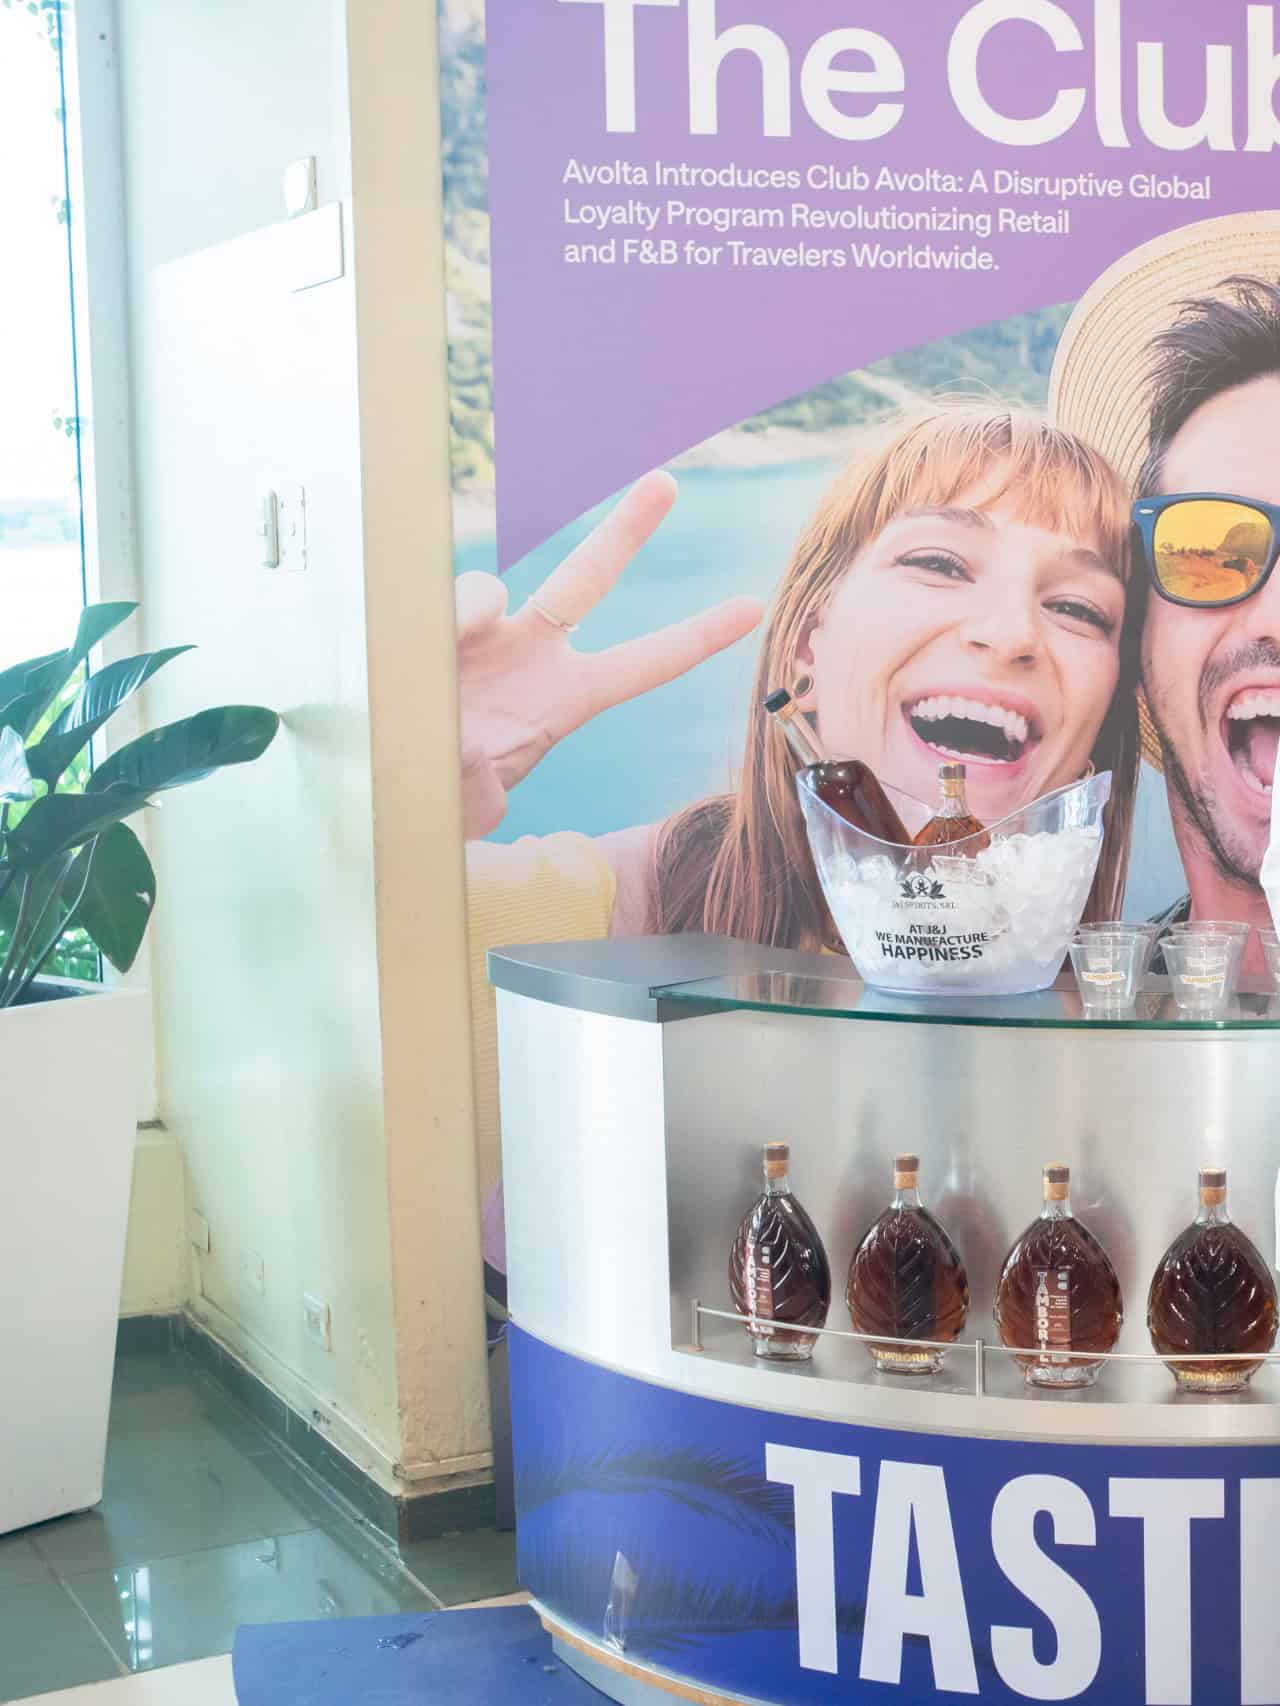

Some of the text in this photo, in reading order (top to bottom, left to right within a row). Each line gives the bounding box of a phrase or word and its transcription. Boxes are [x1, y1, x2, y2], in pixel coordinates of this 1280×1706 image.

[557, 0, 905, 141] The
[562, 158, 1211, 200] Avolta Introduces Club Avolta: A Disruptive Global
[563, 198, 1070, 238] Loyalty Program Revolutionizing Retail
[564, 238, 1001, 271] and F&B for Travelers Worldwide.
[876, 930, 990, 946] WE MANUFACTURE
[909, 924, 947, 935] AT J&J
[881, 942, 983, 961] HAPPINESS
